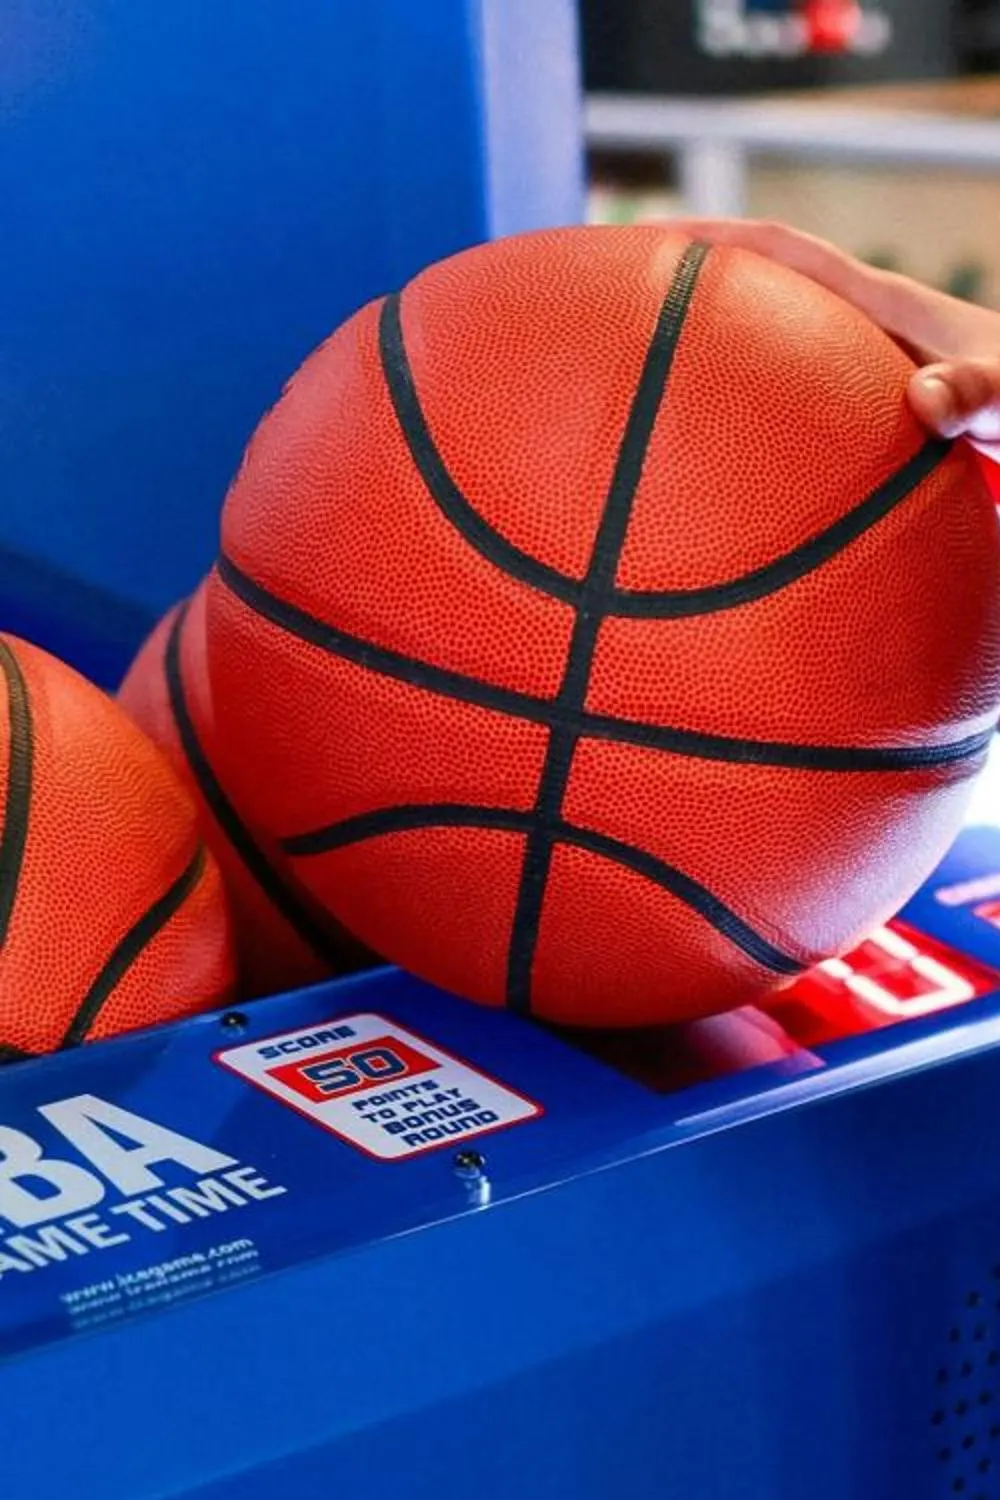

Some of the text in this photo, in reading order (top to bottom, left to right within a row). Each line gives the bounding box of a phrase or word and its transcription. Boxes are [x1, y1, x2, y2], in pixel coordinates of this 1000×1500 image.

[257, 1025, 357, 1060] SCORE
[299, 1046, 410, 1094] 50
[351, 1079, 441, 1111] POINTS
[360, 1087, 464, 1123] TO PLAY
[381, 1098, 482, 1135] BONUS
[399, 1110, 500, 1147] ROUND
[0, 1093, 240, 1229] BA
[0, 1167, 288, 1281] AME TIME
